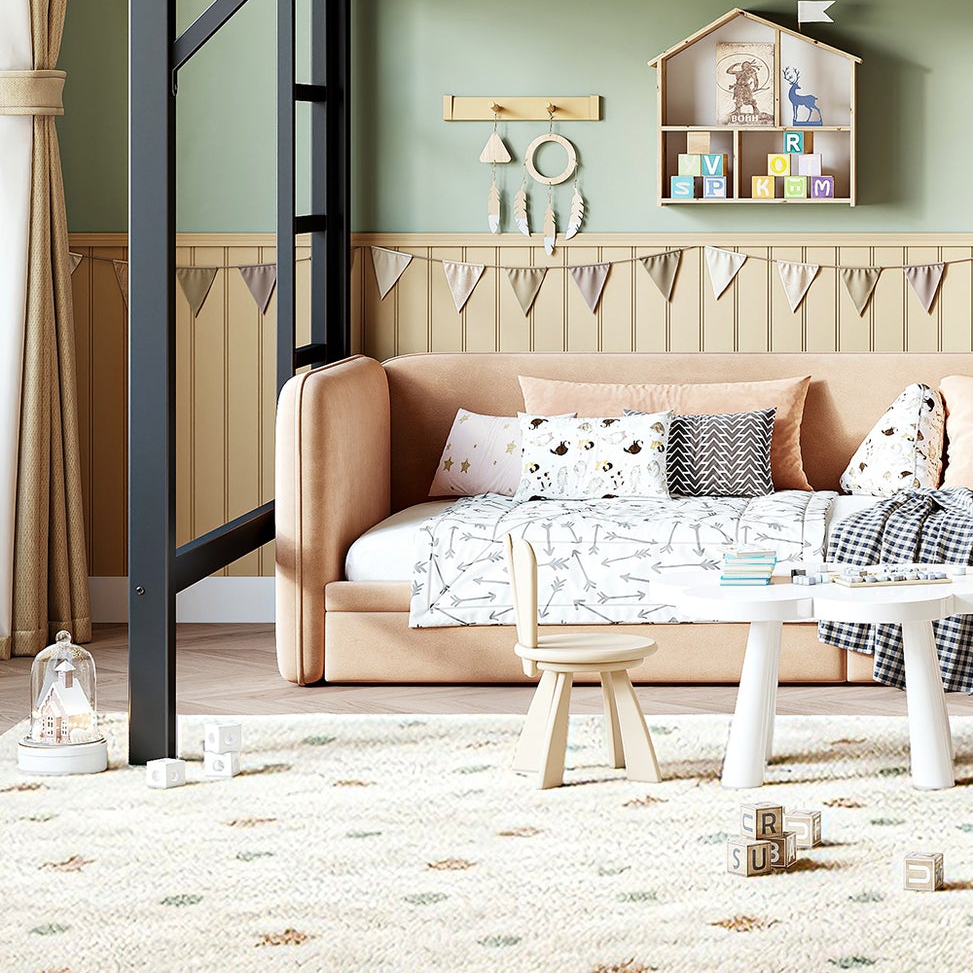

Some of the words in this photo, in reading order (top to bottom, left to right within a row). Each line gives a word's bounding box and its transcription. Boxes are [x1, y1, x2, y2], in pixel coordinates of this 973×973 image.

[786, 133, 801, 152] R
[703, 155, 721, 175] V
[770, 156, 787, 174] O
[674, 181, 691, 195] S
[707, 180, 723, 196] P
[756, 178, 770, 196] K
[814, 179, 831, 197] M
[761, 812, 776, 835] R
[733, 848, 740, 869] S
[752, 847, 766, 870] U
